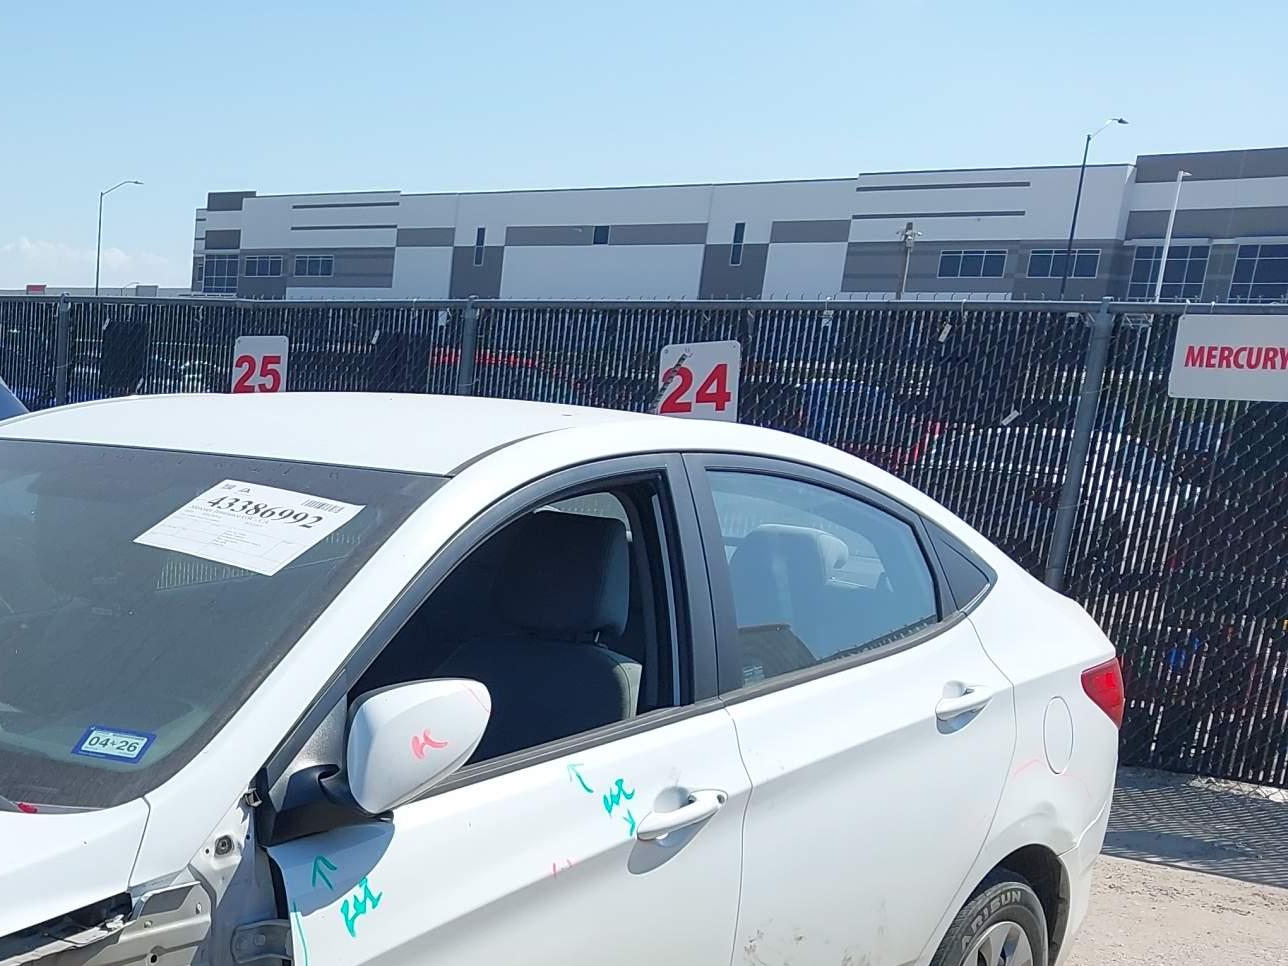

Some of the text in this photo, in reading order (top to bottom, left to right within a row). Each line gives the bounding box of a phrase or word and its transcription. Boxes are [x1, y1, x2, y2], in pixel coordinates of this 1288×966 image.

[233, 354, 282, 394] 25
[1184, 345, 1288, 370] MERCURY
[660, 363, 732, 414] 24
[207, 495, 323, 529] 43386992
